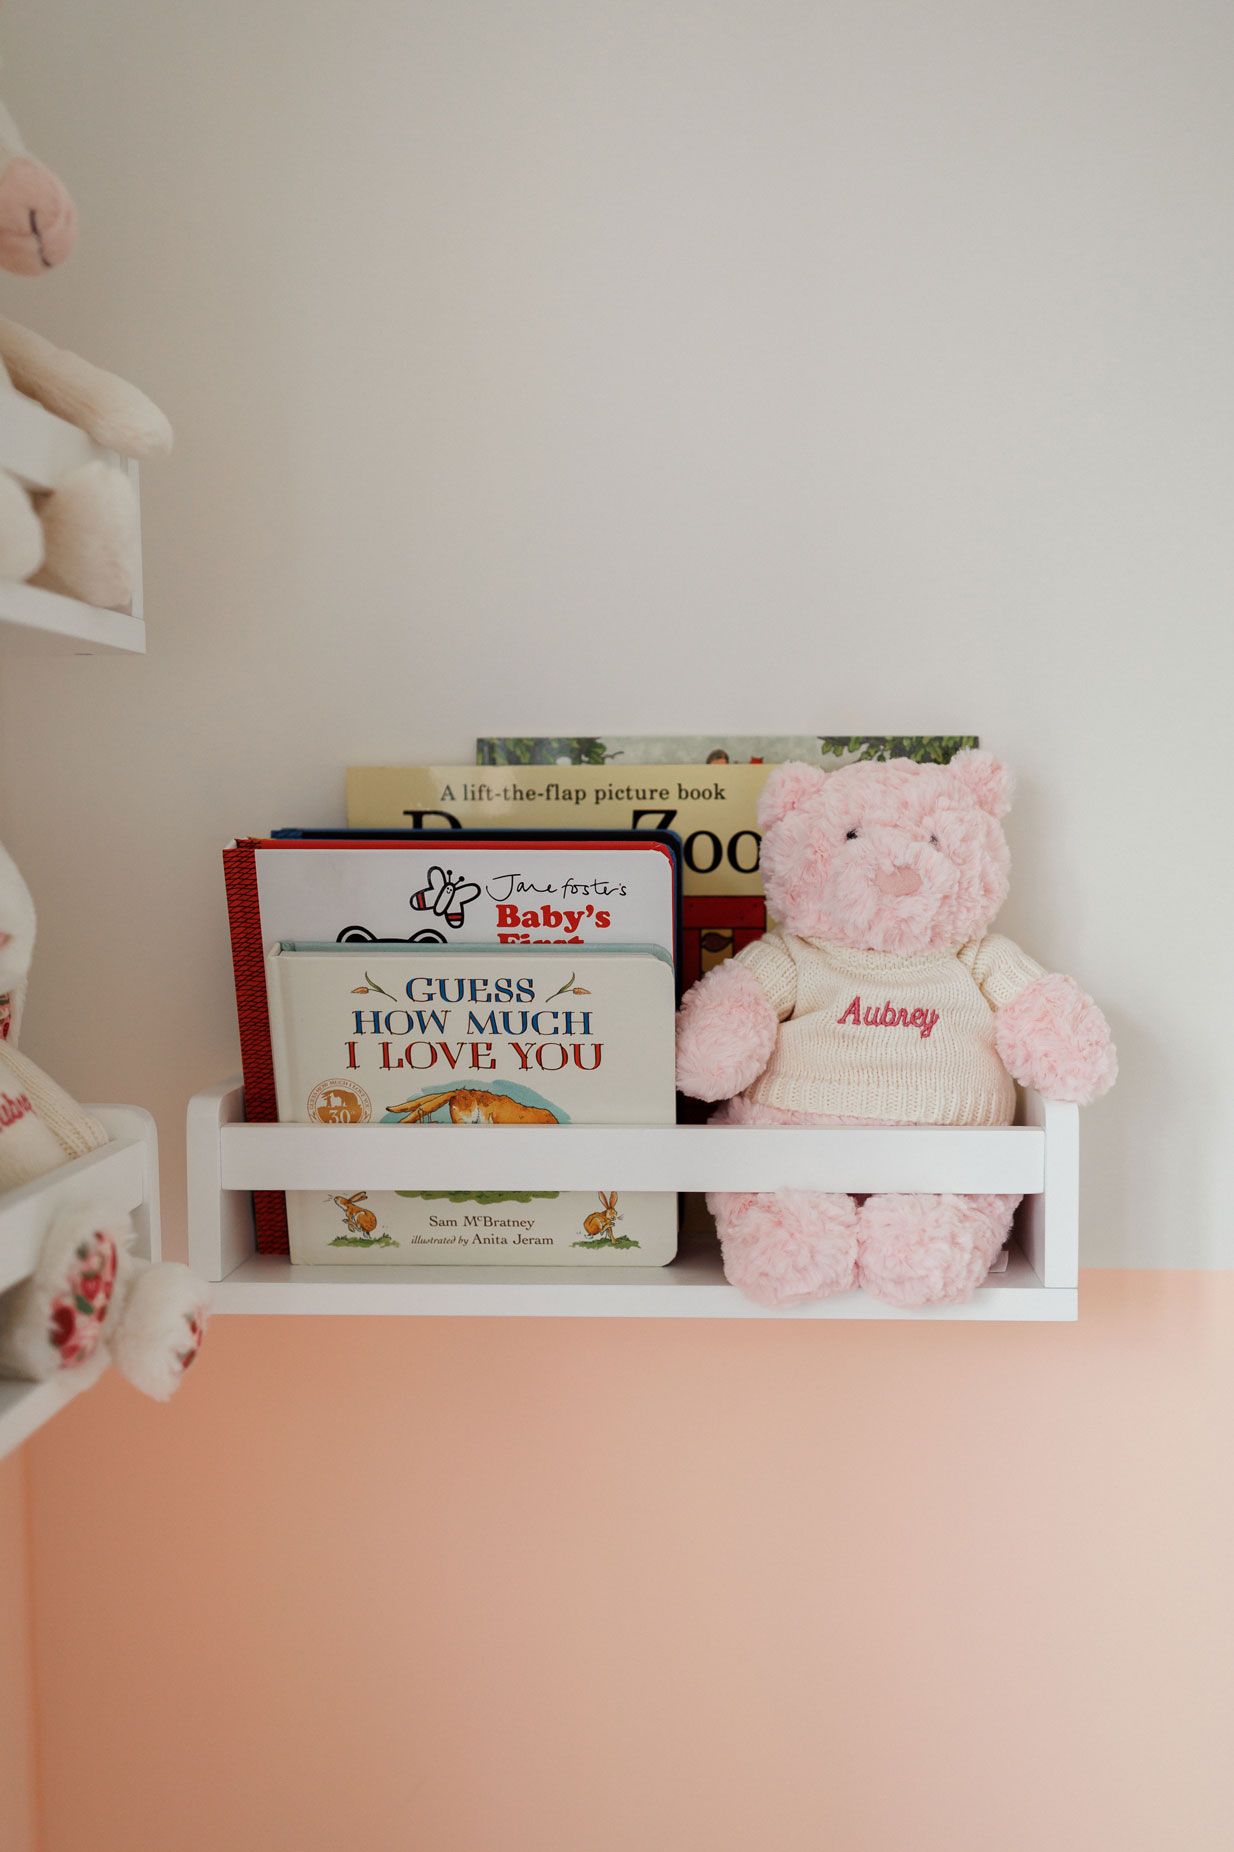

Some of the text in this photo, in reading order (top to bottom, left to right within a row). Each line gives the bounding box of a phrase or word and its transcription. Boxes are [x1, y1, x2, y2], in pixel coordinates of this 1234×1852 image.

[440, 783, 726, 804] A lift-the-flap picture book
[485, 873, 558, 901] Jane
[495, 904, 611, 933] Baby's
[405, 976, 536, 1004] GUESS
[351, 1008, 594, 1036] HOW MUCH
[836, 995, 940, 1040] Aubrey
[344, 1040, 605, 1072] I LOVE YOU
[429, 1215, 535, 1230] Sam McBratney
[411, 1233, 554, 1246] illustrated by Anita Jeram
